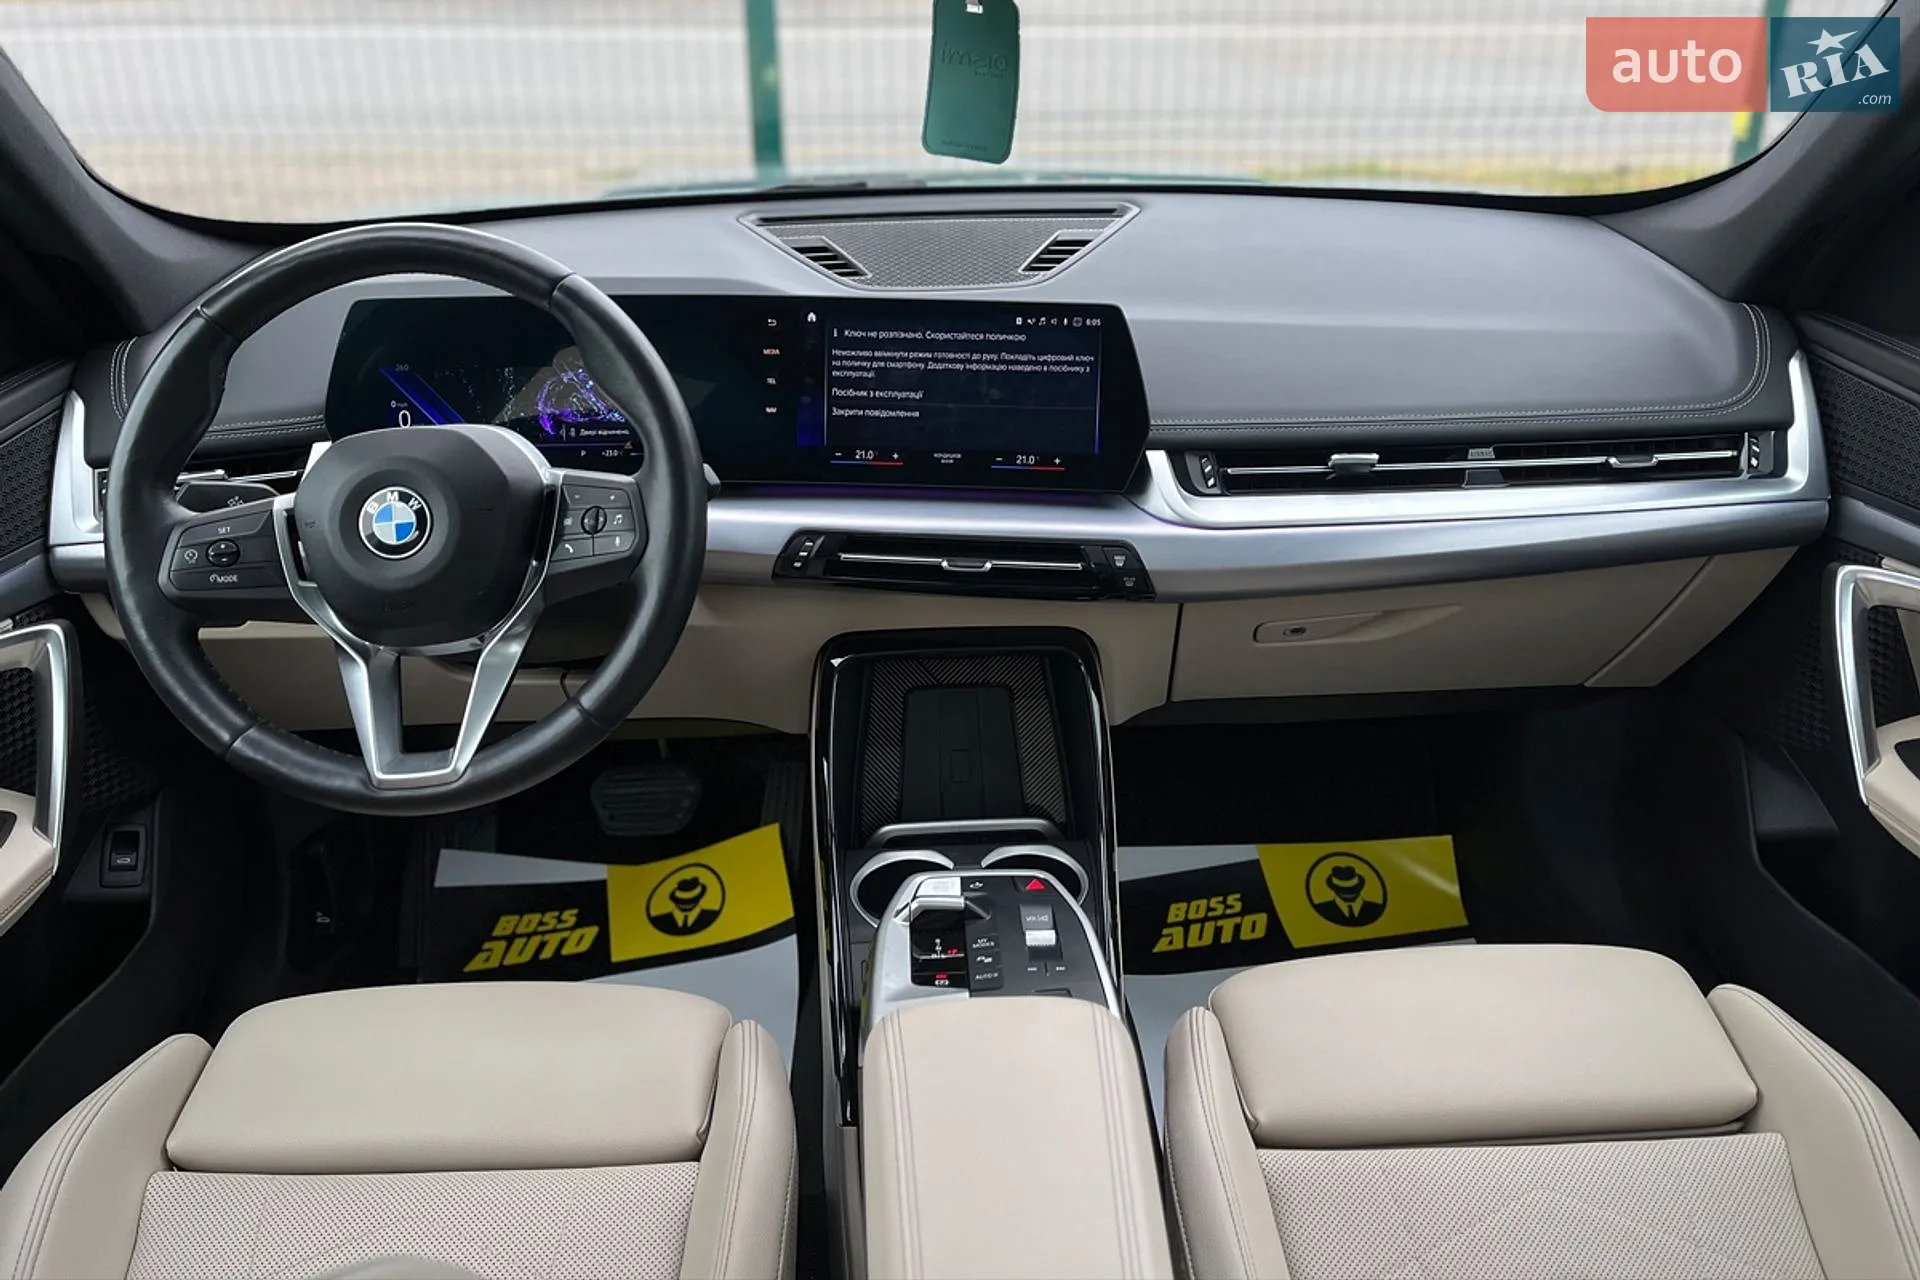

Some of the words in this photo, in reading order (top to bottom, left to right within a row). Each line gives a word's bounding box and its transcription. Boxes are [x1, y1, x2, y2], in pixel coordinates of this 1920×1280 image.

[844, 329, 866, 337] Ключ
[399, 410, 411, 428] 0
[366, 491, 422, 514] BMW
[492, 908, 579, 937] BOSS
[1166, 893, 1243, 924] BOSS
[1152, 912, 1268, 953] AUTO
[463, 926, 600, 972] AUTO
